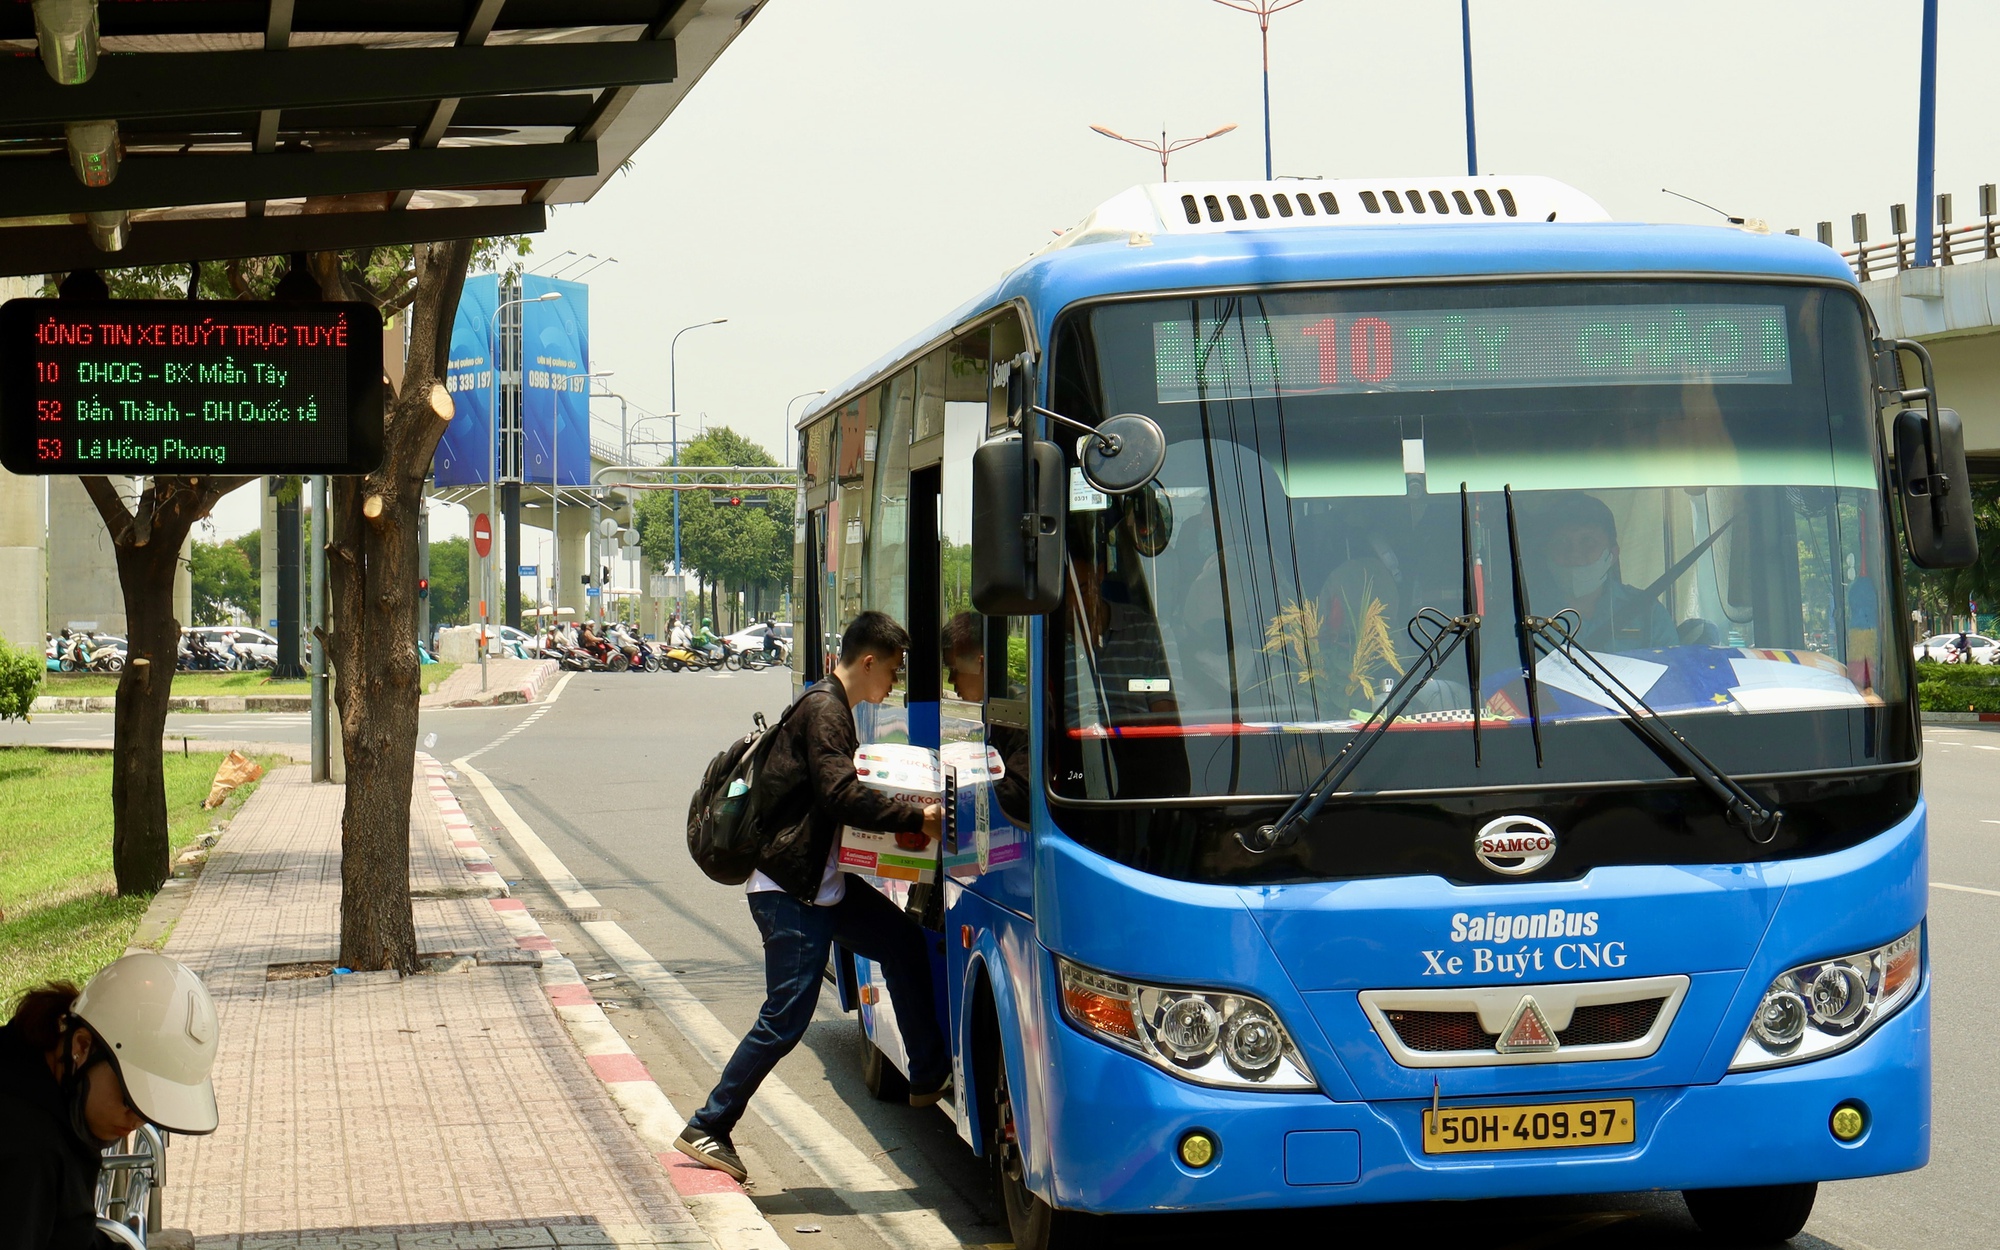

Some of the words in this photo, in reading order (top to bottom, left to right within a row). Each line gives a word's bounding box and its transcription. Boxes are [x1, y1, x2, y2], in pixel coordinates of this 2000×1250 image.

[98, 324, 132, 346] TIN
[137, 324, 166, 346] XE
[171, 318, 229, 346] BUÝT
[233, 322, 289, 351] TRỰC
[1302, 316, 1393, 385] 10
[1406, 314, 1510, 373] TÂY
[1577, 308, 1743, 368] CHÀO
[37, 361, 60, 383] 10
[77, 361, 142, 384] ĐHQG
[165, 362, 193, 385] BX
[199, 356, 247, 385] Miền
[252, 363, 288, 388] Tây
[459, 372, 475, 392] 339
[477, 370, 491, 389] 197
[529, 369, 550, 390] 0966
[551, 372, 567, 392] 339
[569, 375, 585, 393] 197
[37, 400, 62, 420] 52
[77, 393, 113, 421] Bến
[119, 400, 180, 422] Thành
[203, 401, 234, 422] ĐH
[238, 398, 290, 422] Quốc
[297, 393, 318, 422] tế
[37, 438, 62, 460] 53
[77, 439, 101, 460] Lê
[107, 436, 158, 464] Hồng
[163, 438, 226, 464] Phong
[1482, 836, 1551, 853] SAMCO
[1450, 909, 1599, 944] SaigonBus
[1421, 950, 1463, 976] Xe
[1473, 944, 1545, 978] Buýt
[1553, 941, 1628, 970] CNG
[1442, 1109, 1617, 1144] 50H-409.97
